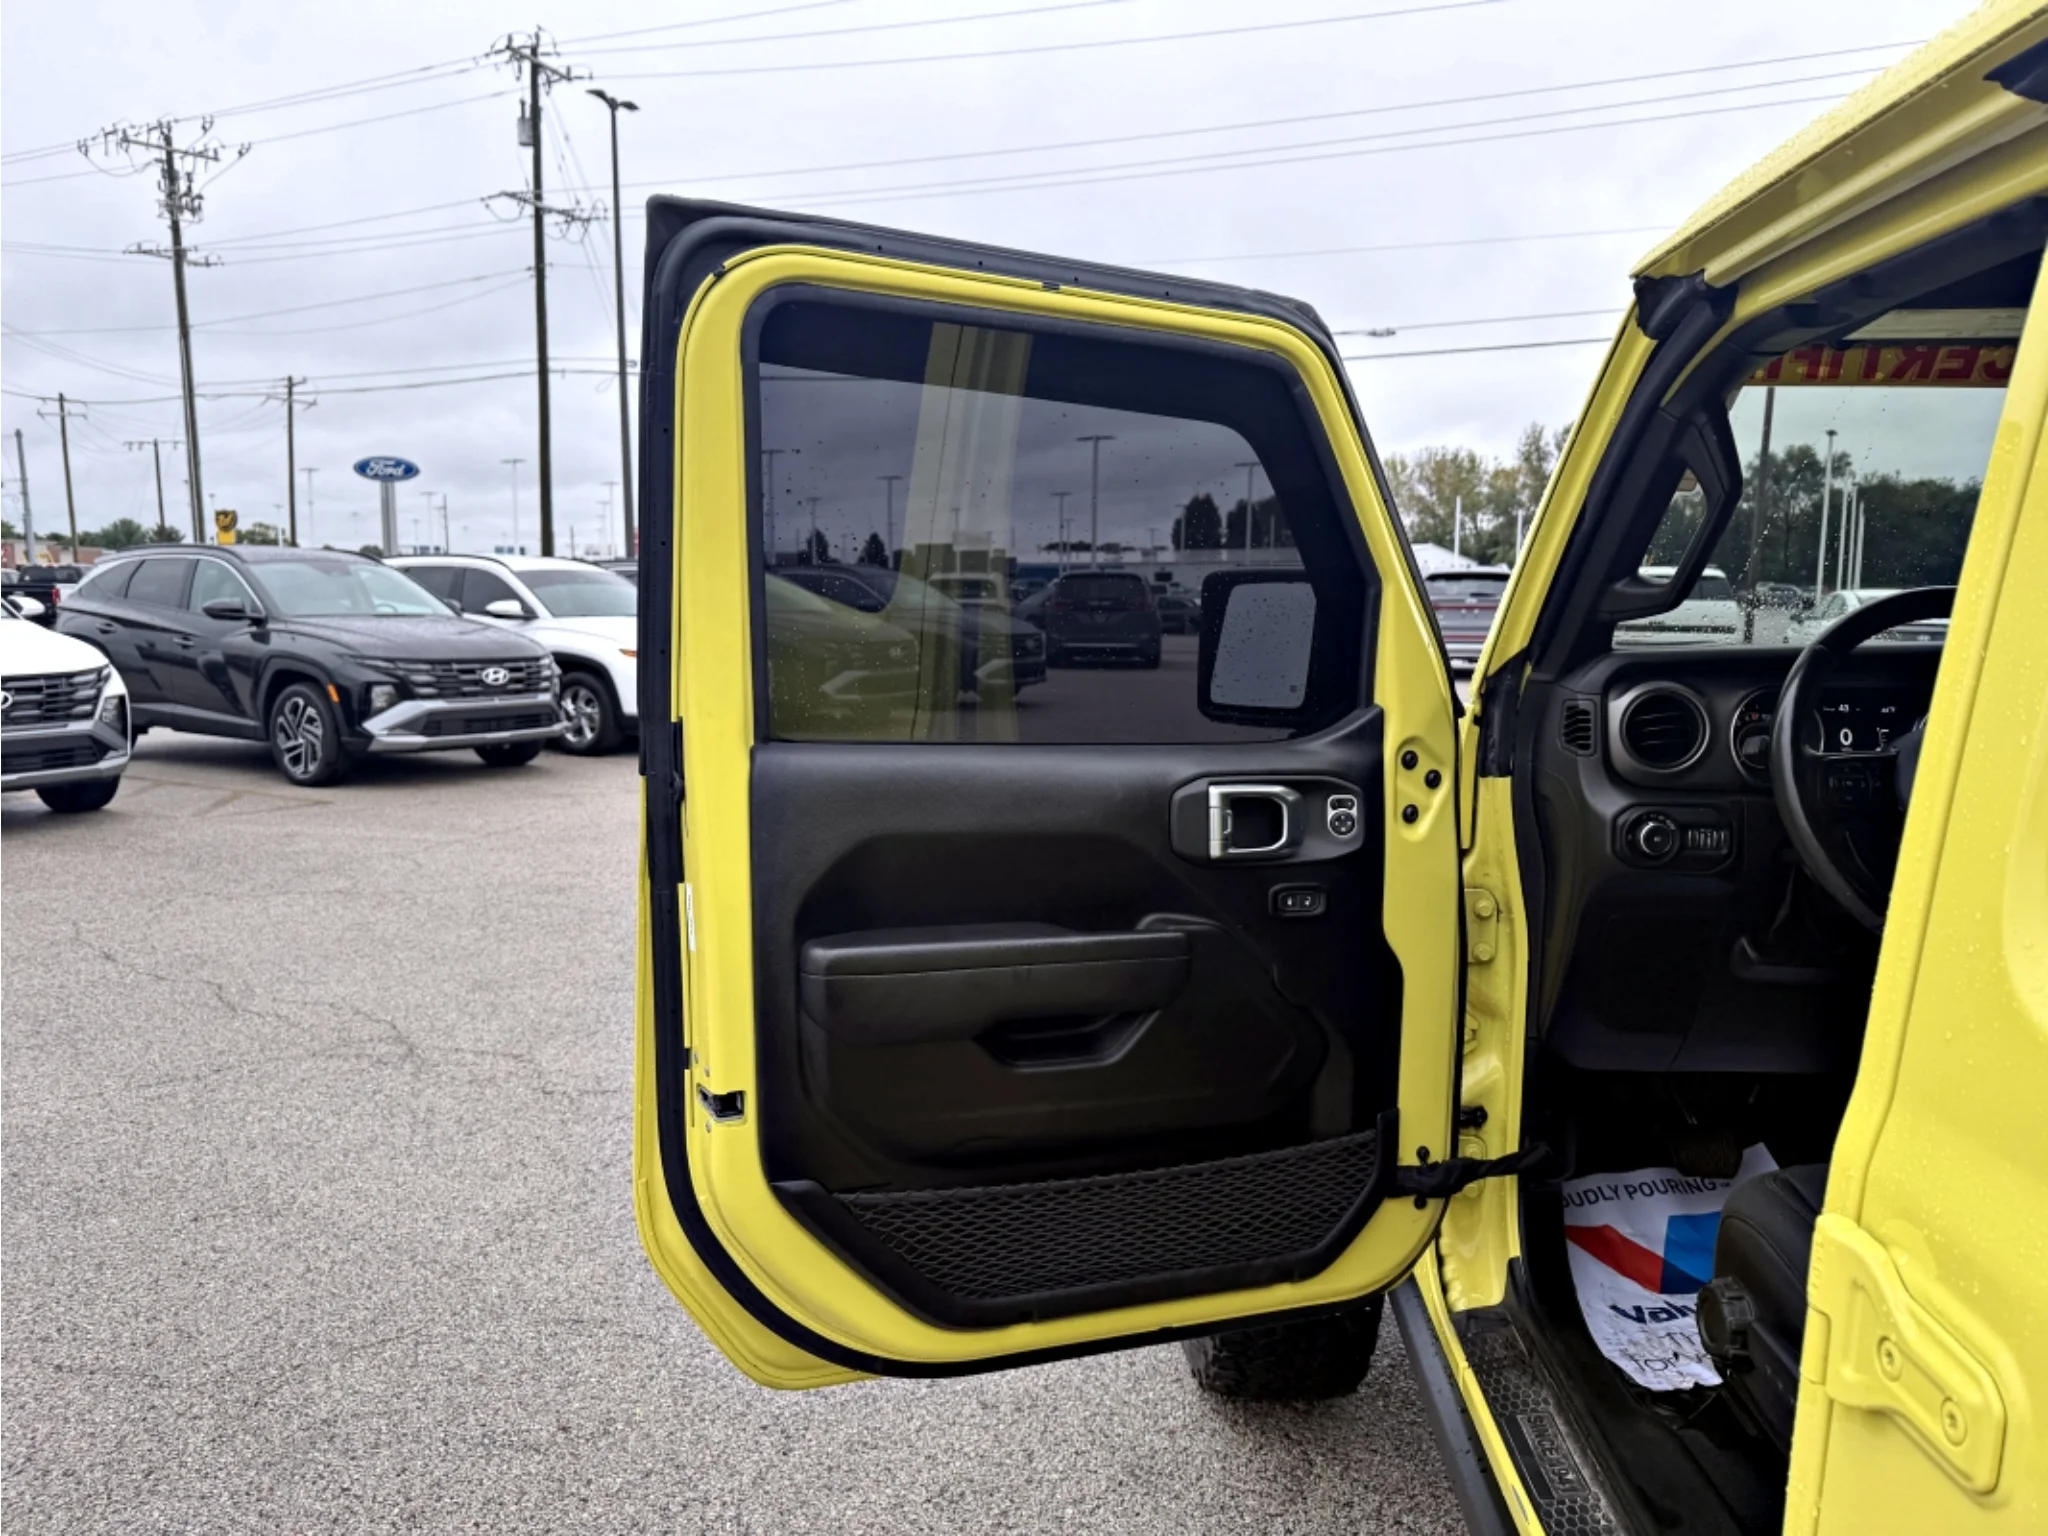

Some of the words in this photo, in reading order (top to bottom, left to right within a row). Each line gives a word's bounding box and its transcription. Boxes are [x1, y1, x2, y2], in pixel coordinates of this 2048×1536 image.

[366, 460, 405, 477] Ford
[1840, 728, 1853, 746] 0
[1623, 1177, 1717, 1200] POURING
[1527, 1415, 1559, 1457] SINCE
[1548, 1460, 1582, 1493] 1941
